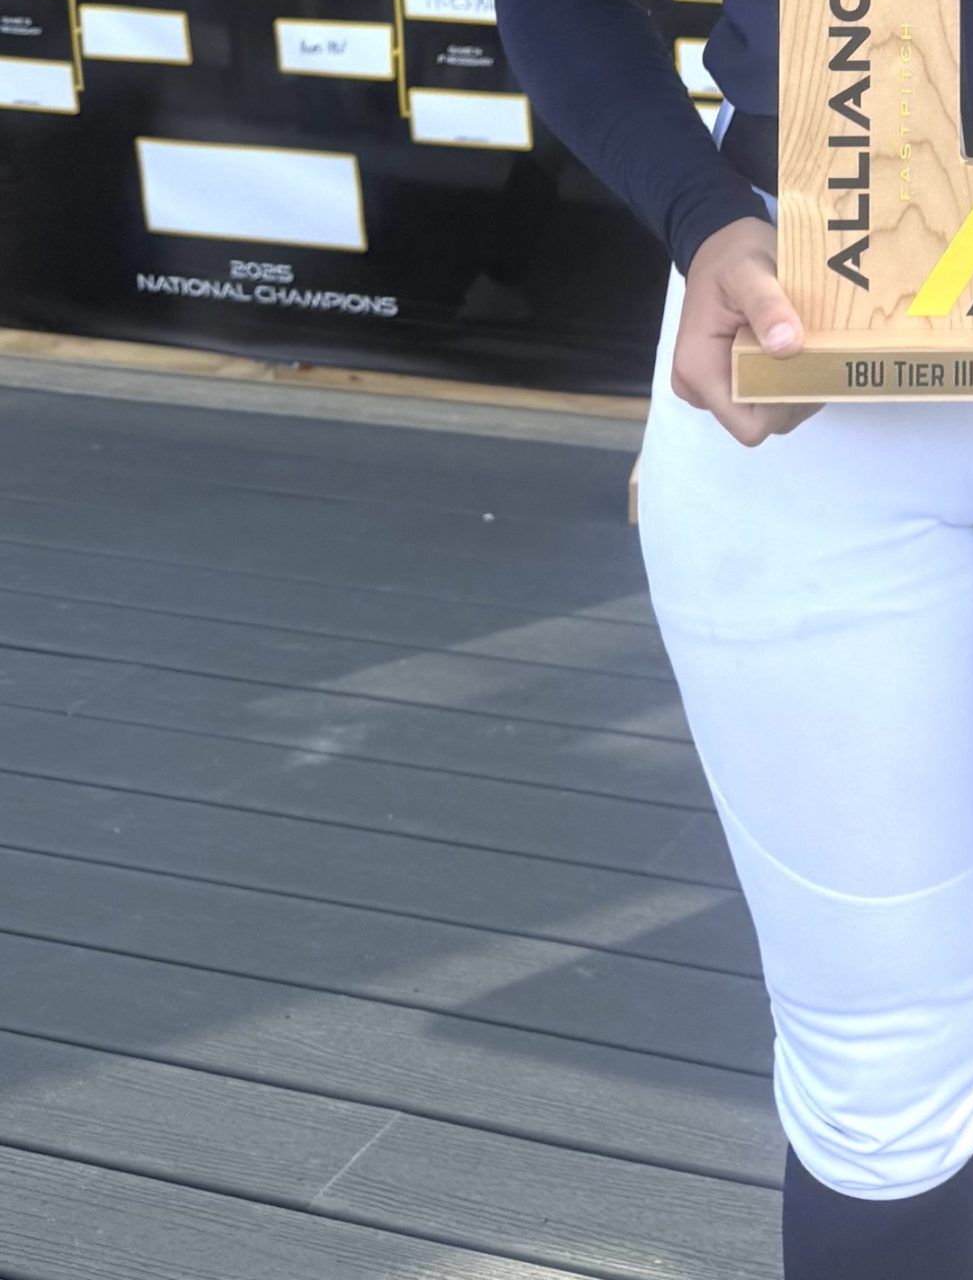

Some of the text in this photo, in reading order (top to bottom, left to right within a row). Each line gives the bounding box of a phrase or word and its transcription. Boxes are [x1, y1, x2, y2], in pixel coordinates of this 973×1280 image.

[900, 23, 913, 201] FASTPITCH
[229, 259, 293, 284] 2025
[137, 272, 399, 317] NATIONAL CHAMPIONS
[845, 361, 884, 387] 18U
[894, 360, 944, 387] TIER
[954, 360, 973, 387] III
